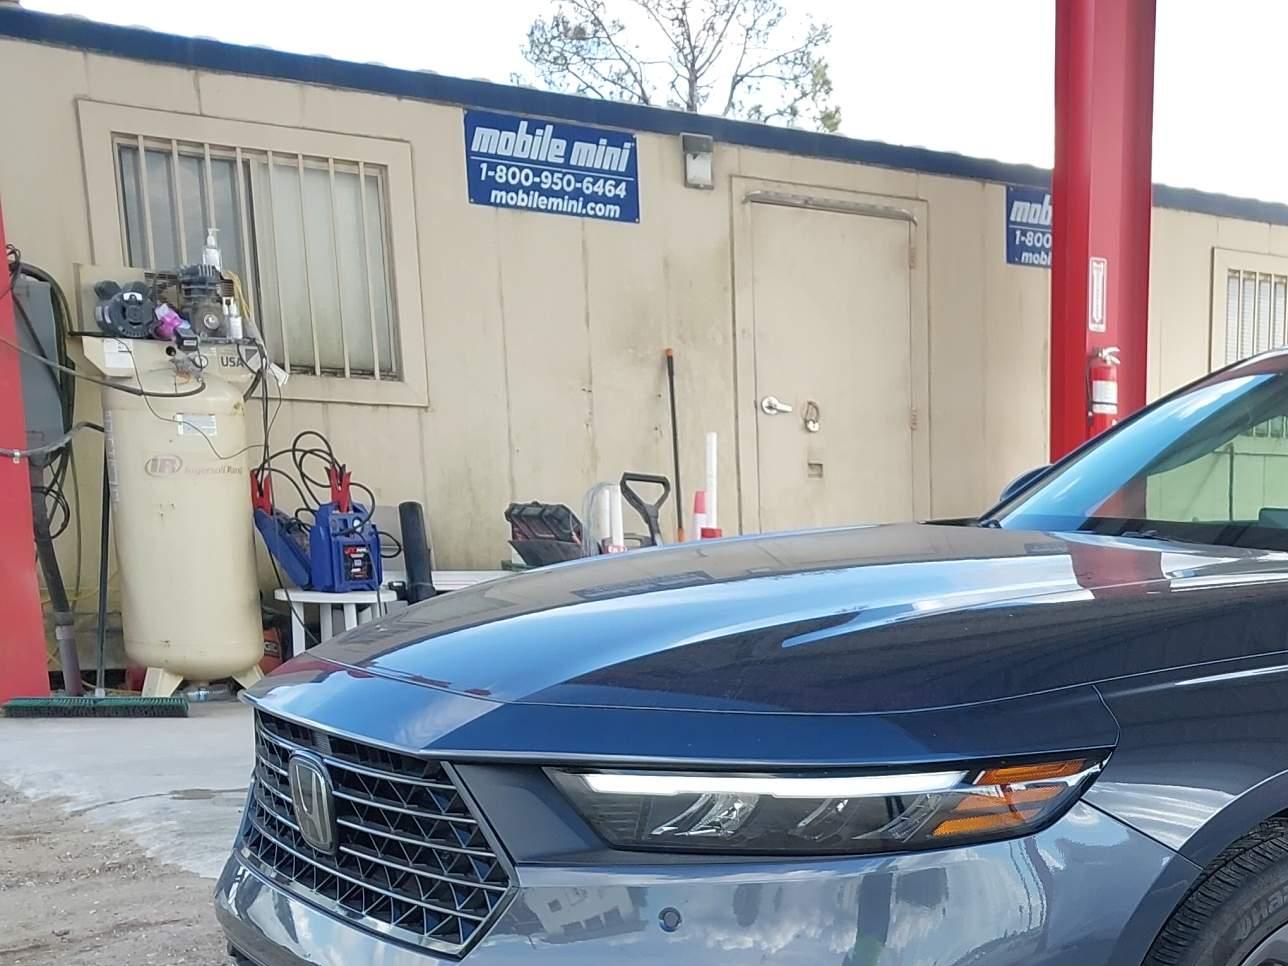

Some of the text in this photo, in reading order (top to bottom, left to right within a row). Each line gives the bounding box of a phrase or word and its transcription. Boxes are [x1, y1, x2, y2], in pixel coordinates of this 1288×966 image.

[471, 120, 632, 172] mobile mini
[479, 162, 627, 199] 1-800-950-6464
[490, 189, 621, 218] mobilemini.com
[220, 356, 244, 368] USA
